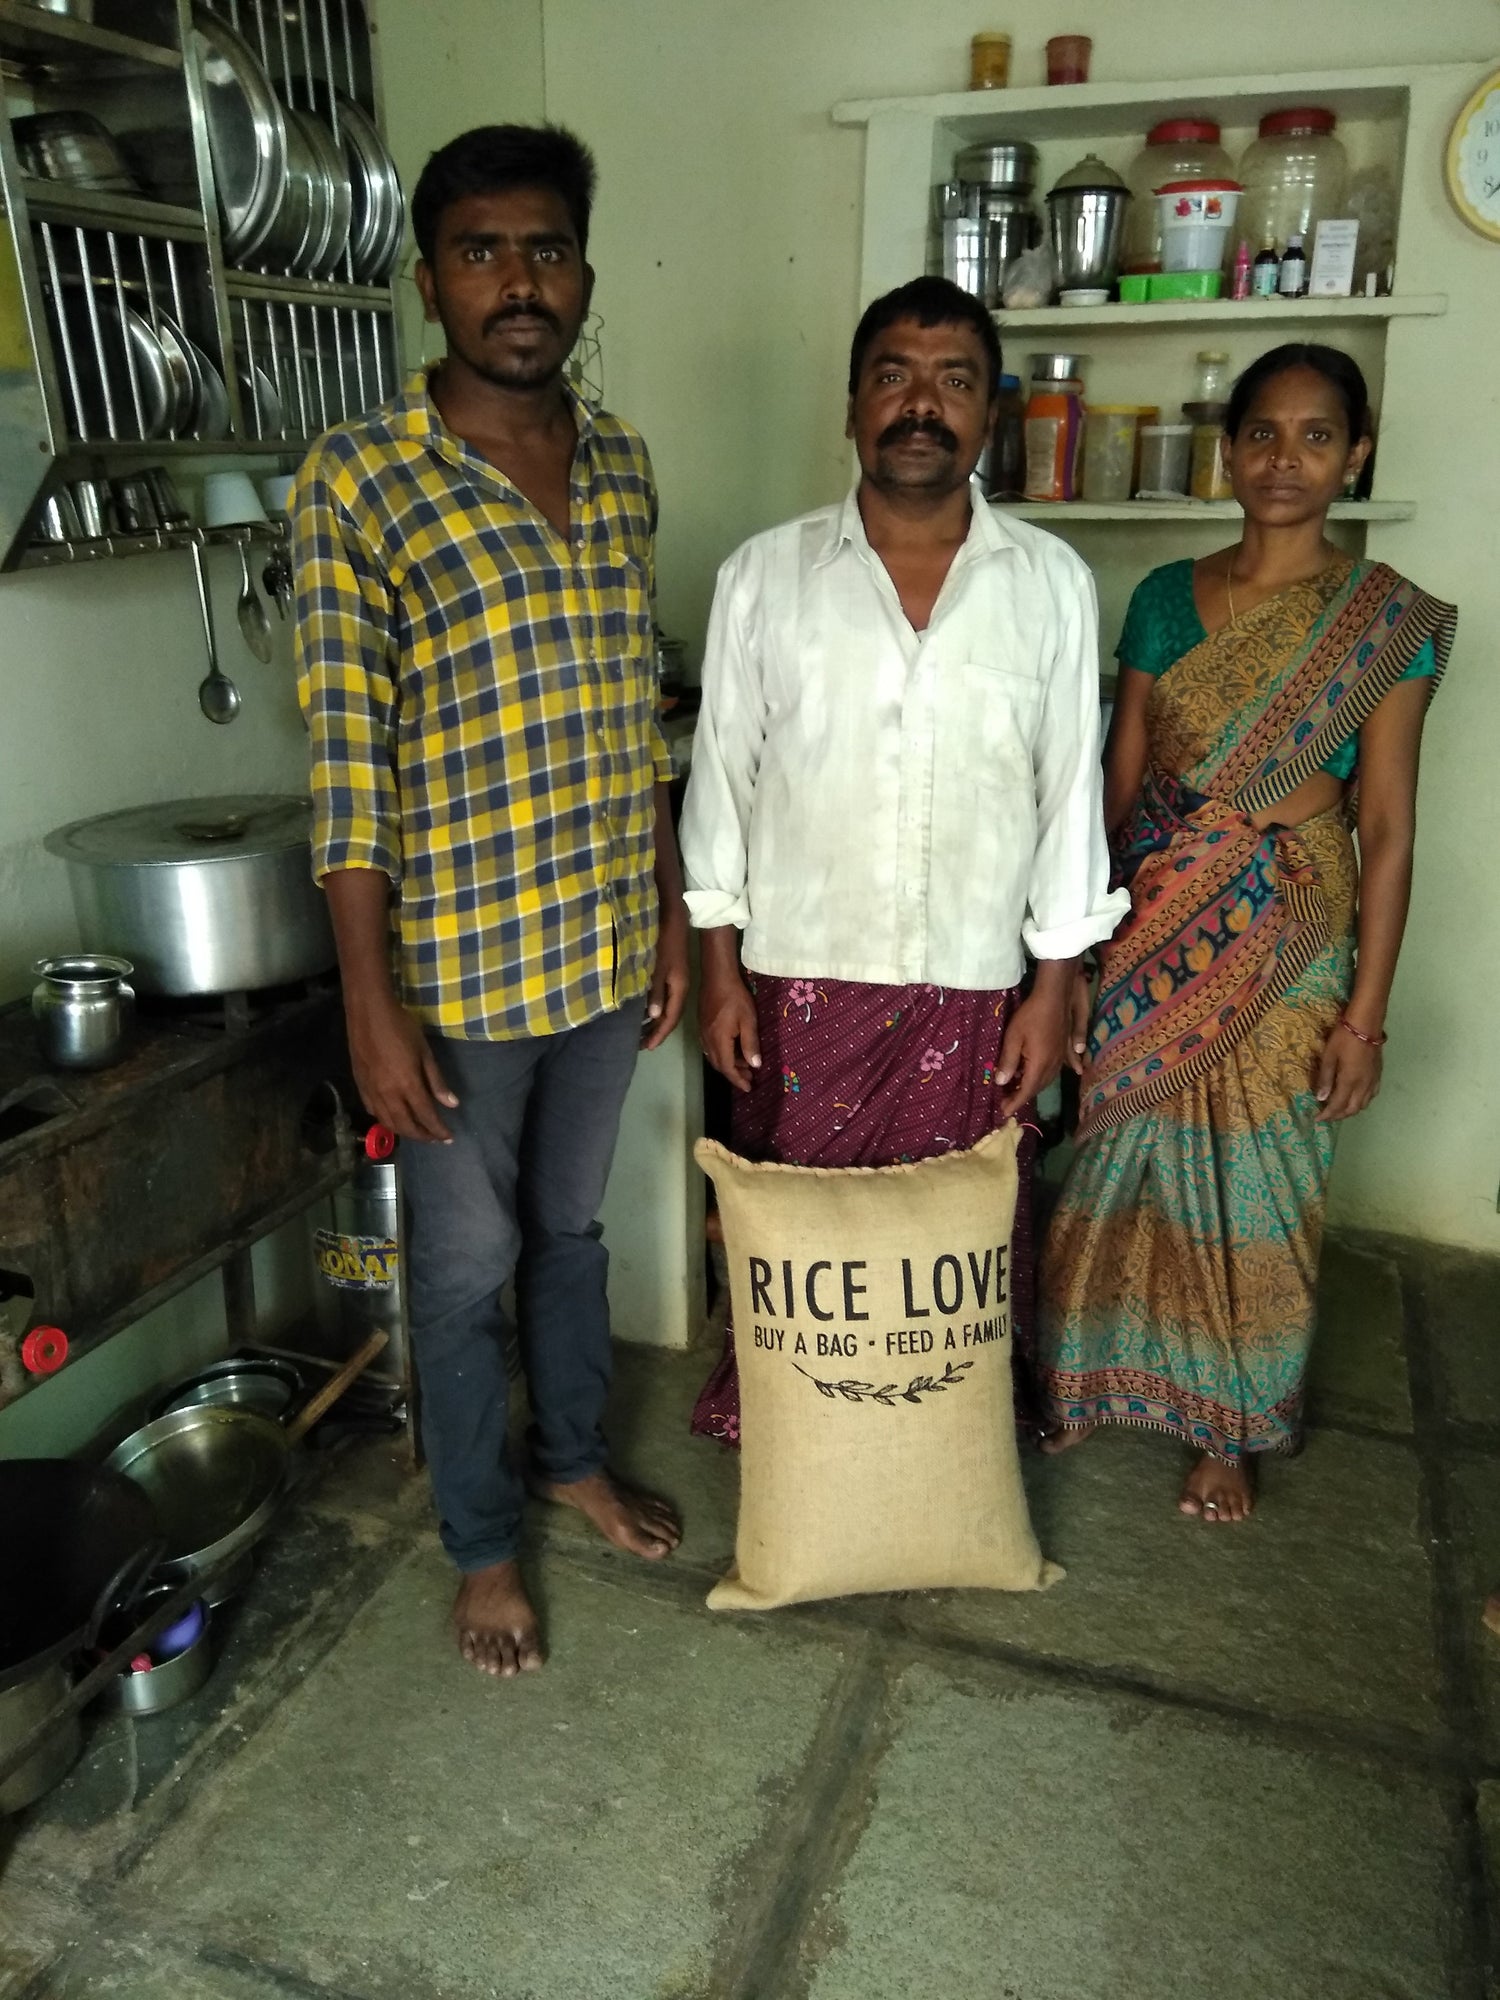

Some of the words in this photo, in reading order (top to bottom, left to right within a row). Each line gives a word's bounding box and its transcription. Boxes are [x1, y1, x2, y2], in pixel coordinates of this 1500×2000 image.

[1484, 119, 1500, 138] 10
[1477, 149, 1488, 166] 9
[749, 1256, 869, 1321] RICE
[902, 1244, 1008, 1318] LOVE
[754, 1325, 785, 1352] BUY
[794, 1332, 807, 1355] A
[817, 1333, 858, 1357] BAG
[886, 1329, 933, 1356] FEED
[944, 1327, 956, 1350] A
[963, 1314, 1007, 1348] FAMILY
